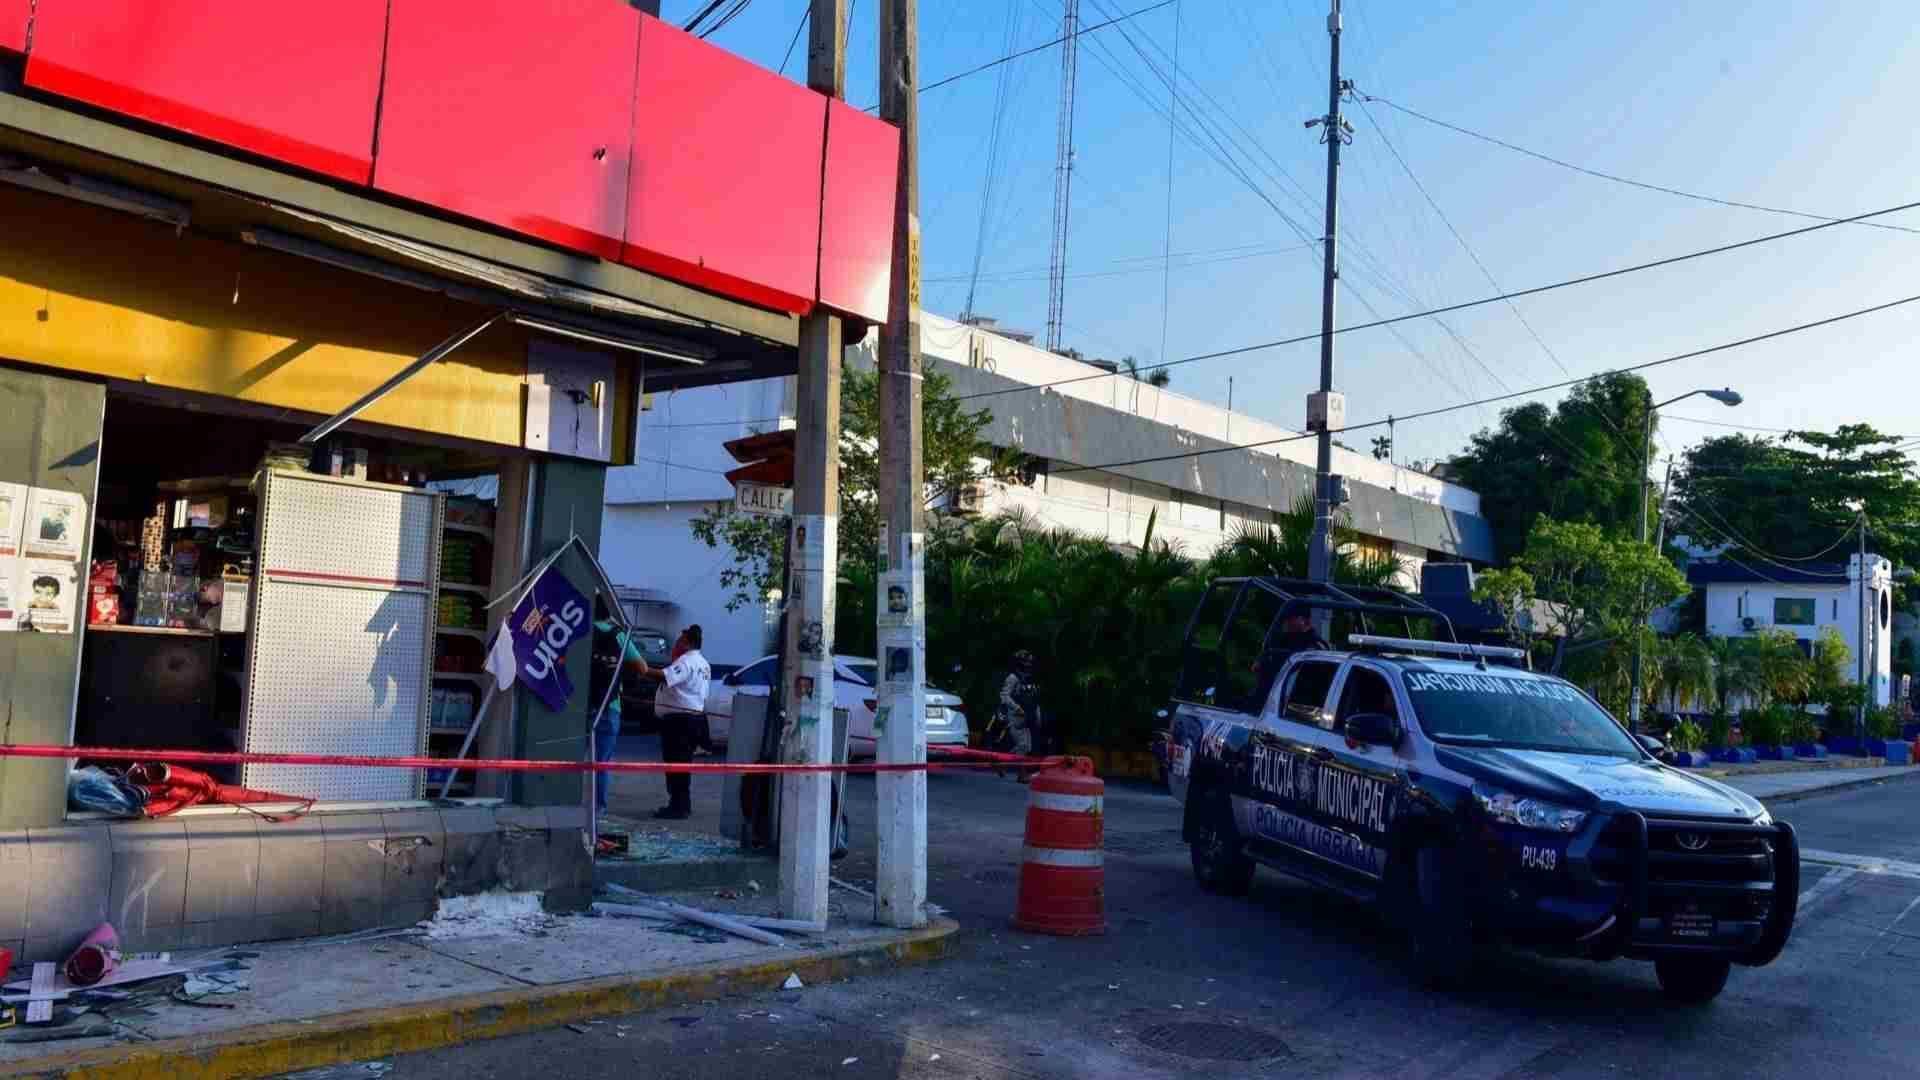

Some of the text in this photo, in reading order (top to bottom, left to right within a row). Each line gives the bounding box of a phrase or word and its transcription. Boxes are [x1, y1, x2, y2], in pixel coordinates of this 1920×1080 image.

[741, 488, 784, 510] CALLE
[525, 600, 584, 680] spin
[1252, 748, 1386, 832] POLICIA MUNICIPAL
[1521, 845, 1556, 872] PU-439
